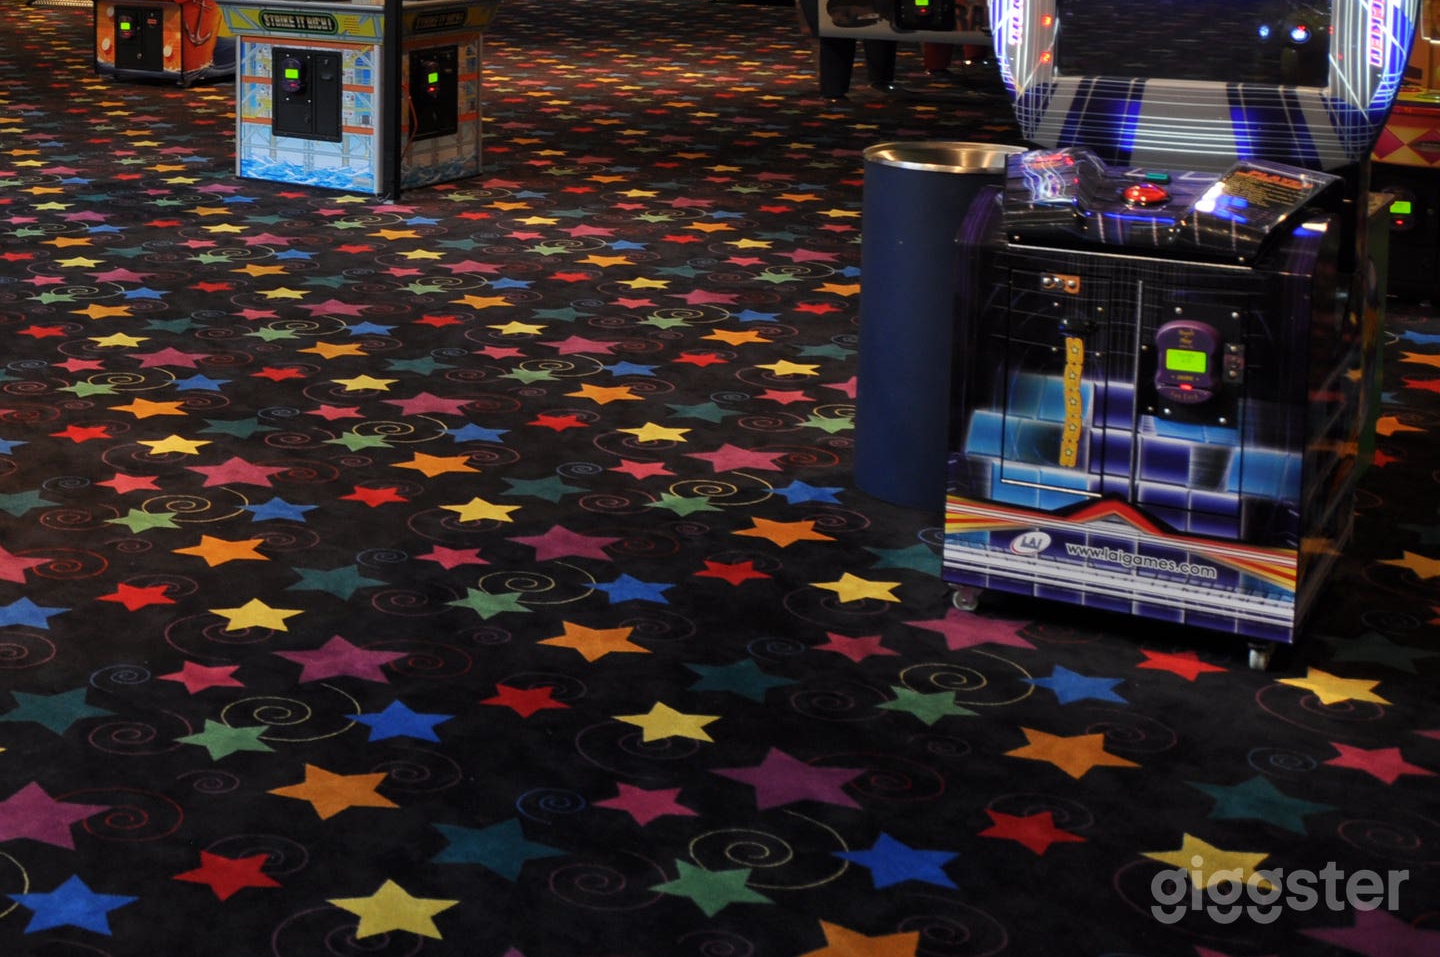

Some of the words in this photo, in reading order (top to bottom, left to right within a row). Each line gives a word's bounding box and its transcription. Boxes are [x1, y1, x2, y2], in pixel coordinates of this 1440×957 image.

[262, 12, 296, 28] STRIKE
[296, 15, 306, 29] IT
[1019, 536, 1043, 551] LAI
[1065, 542, 1218, 580] www.laigames.com
